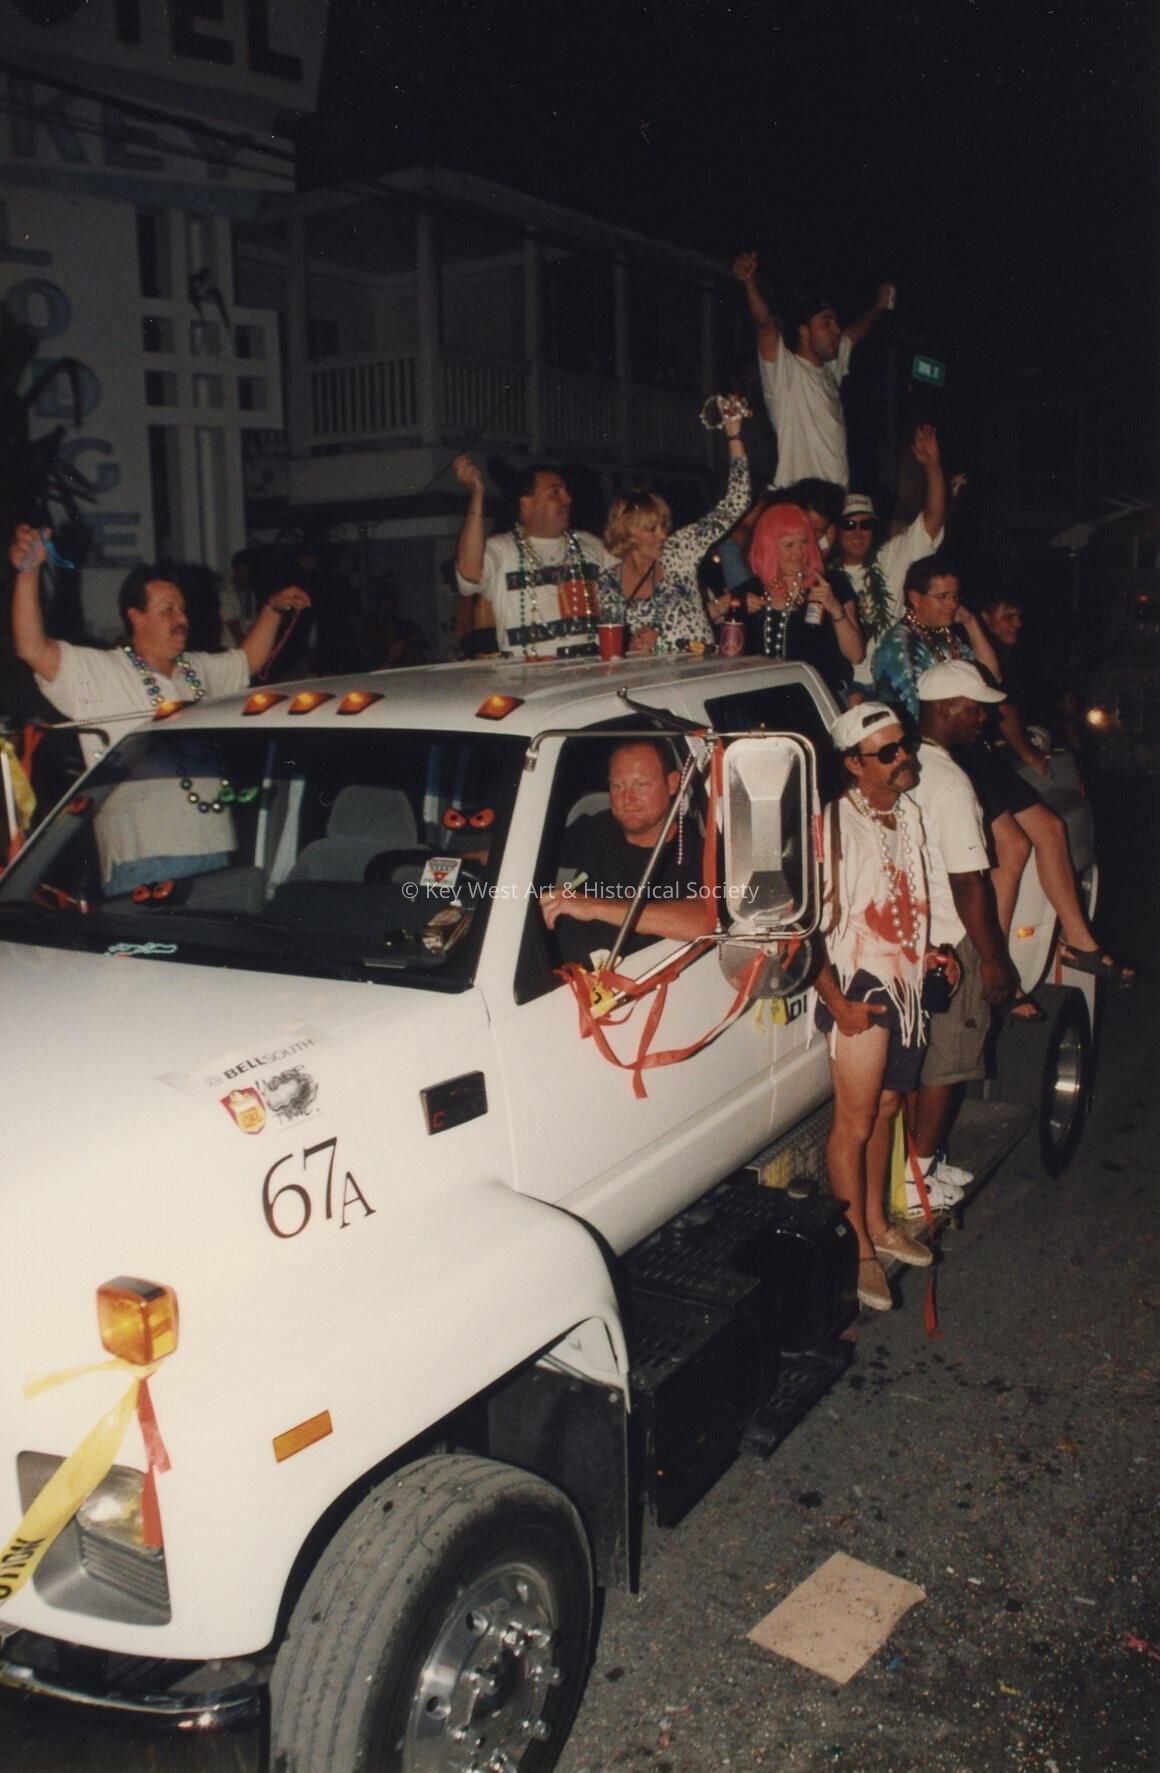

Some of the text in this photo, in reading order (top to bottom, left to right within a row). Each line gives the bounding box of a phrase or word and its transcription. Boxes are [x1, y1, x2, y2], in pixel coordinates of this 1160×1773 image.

[8, 74, 256, 180] KEY
[223, 1039, 315, 1079] BELLSOUTH
[261, 1136, 376, 1239] 67A
